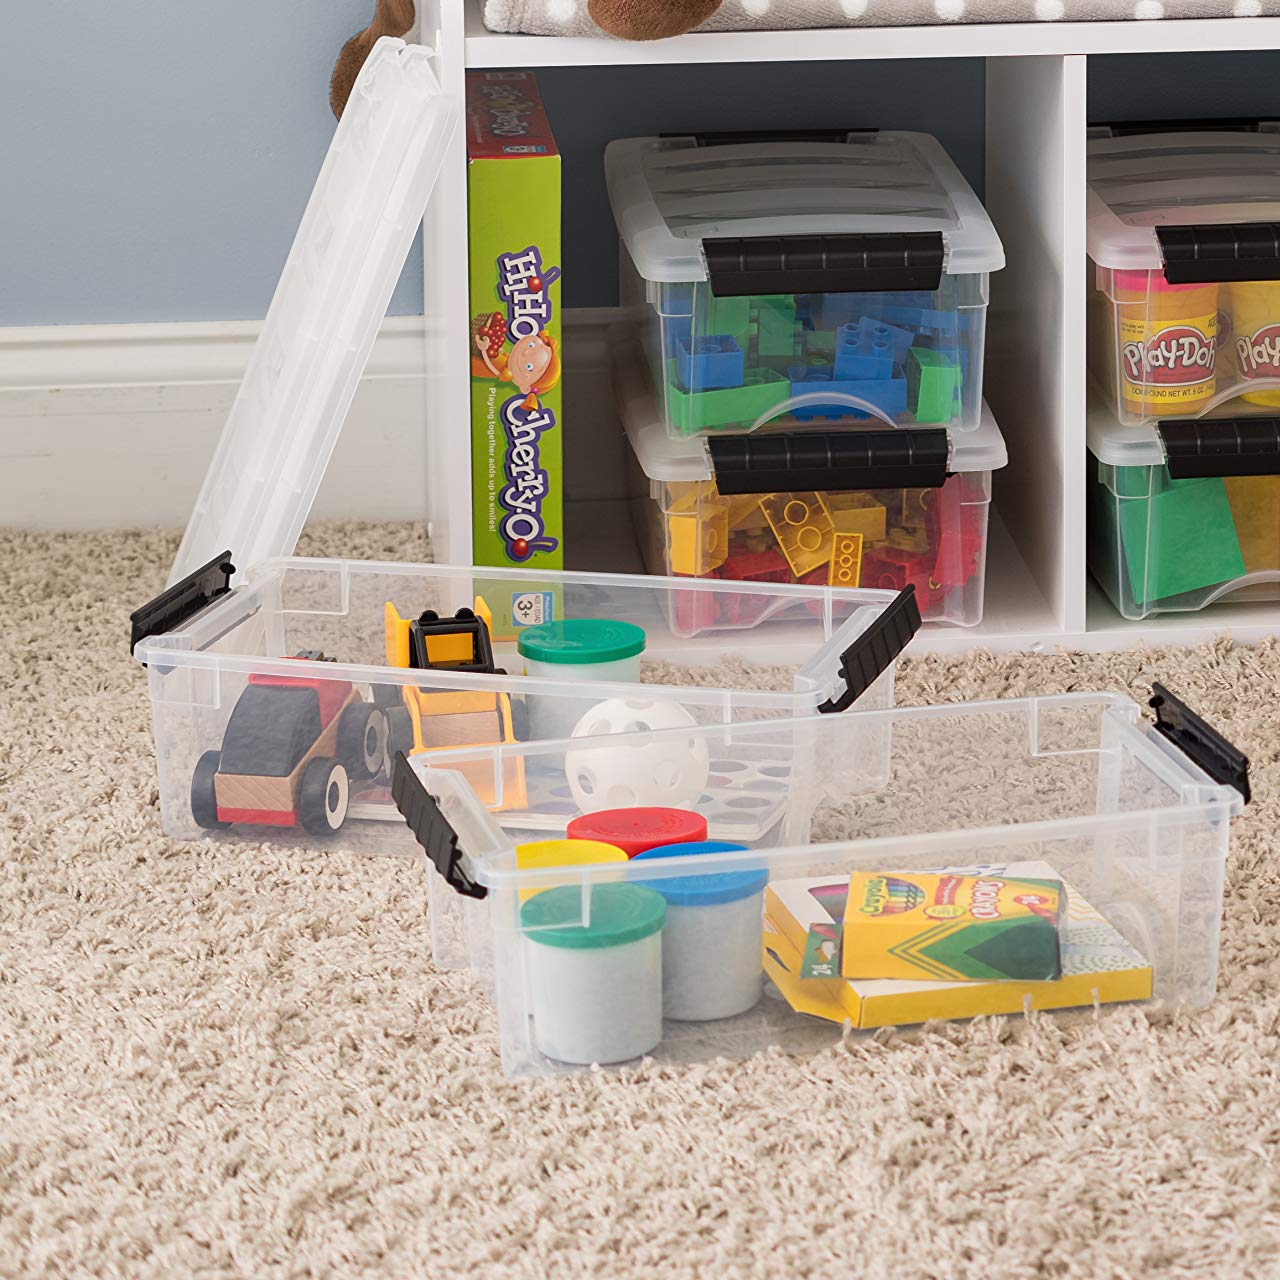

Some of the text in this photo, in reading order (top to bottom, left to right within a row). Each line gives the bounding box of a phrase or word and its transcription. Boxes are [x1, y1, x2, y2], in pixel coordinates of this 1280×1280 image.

[1123, 336, 1216, 377] Play-Doh
[487, 388, 497, 532] Playing together adds up to smiles!
[517, 600, 533, 618] 3+
[857, 877, 884, 914] Crayola
[970, 880, 1005, 919] CRAYONS
[811, 963, 833, 976] 24
